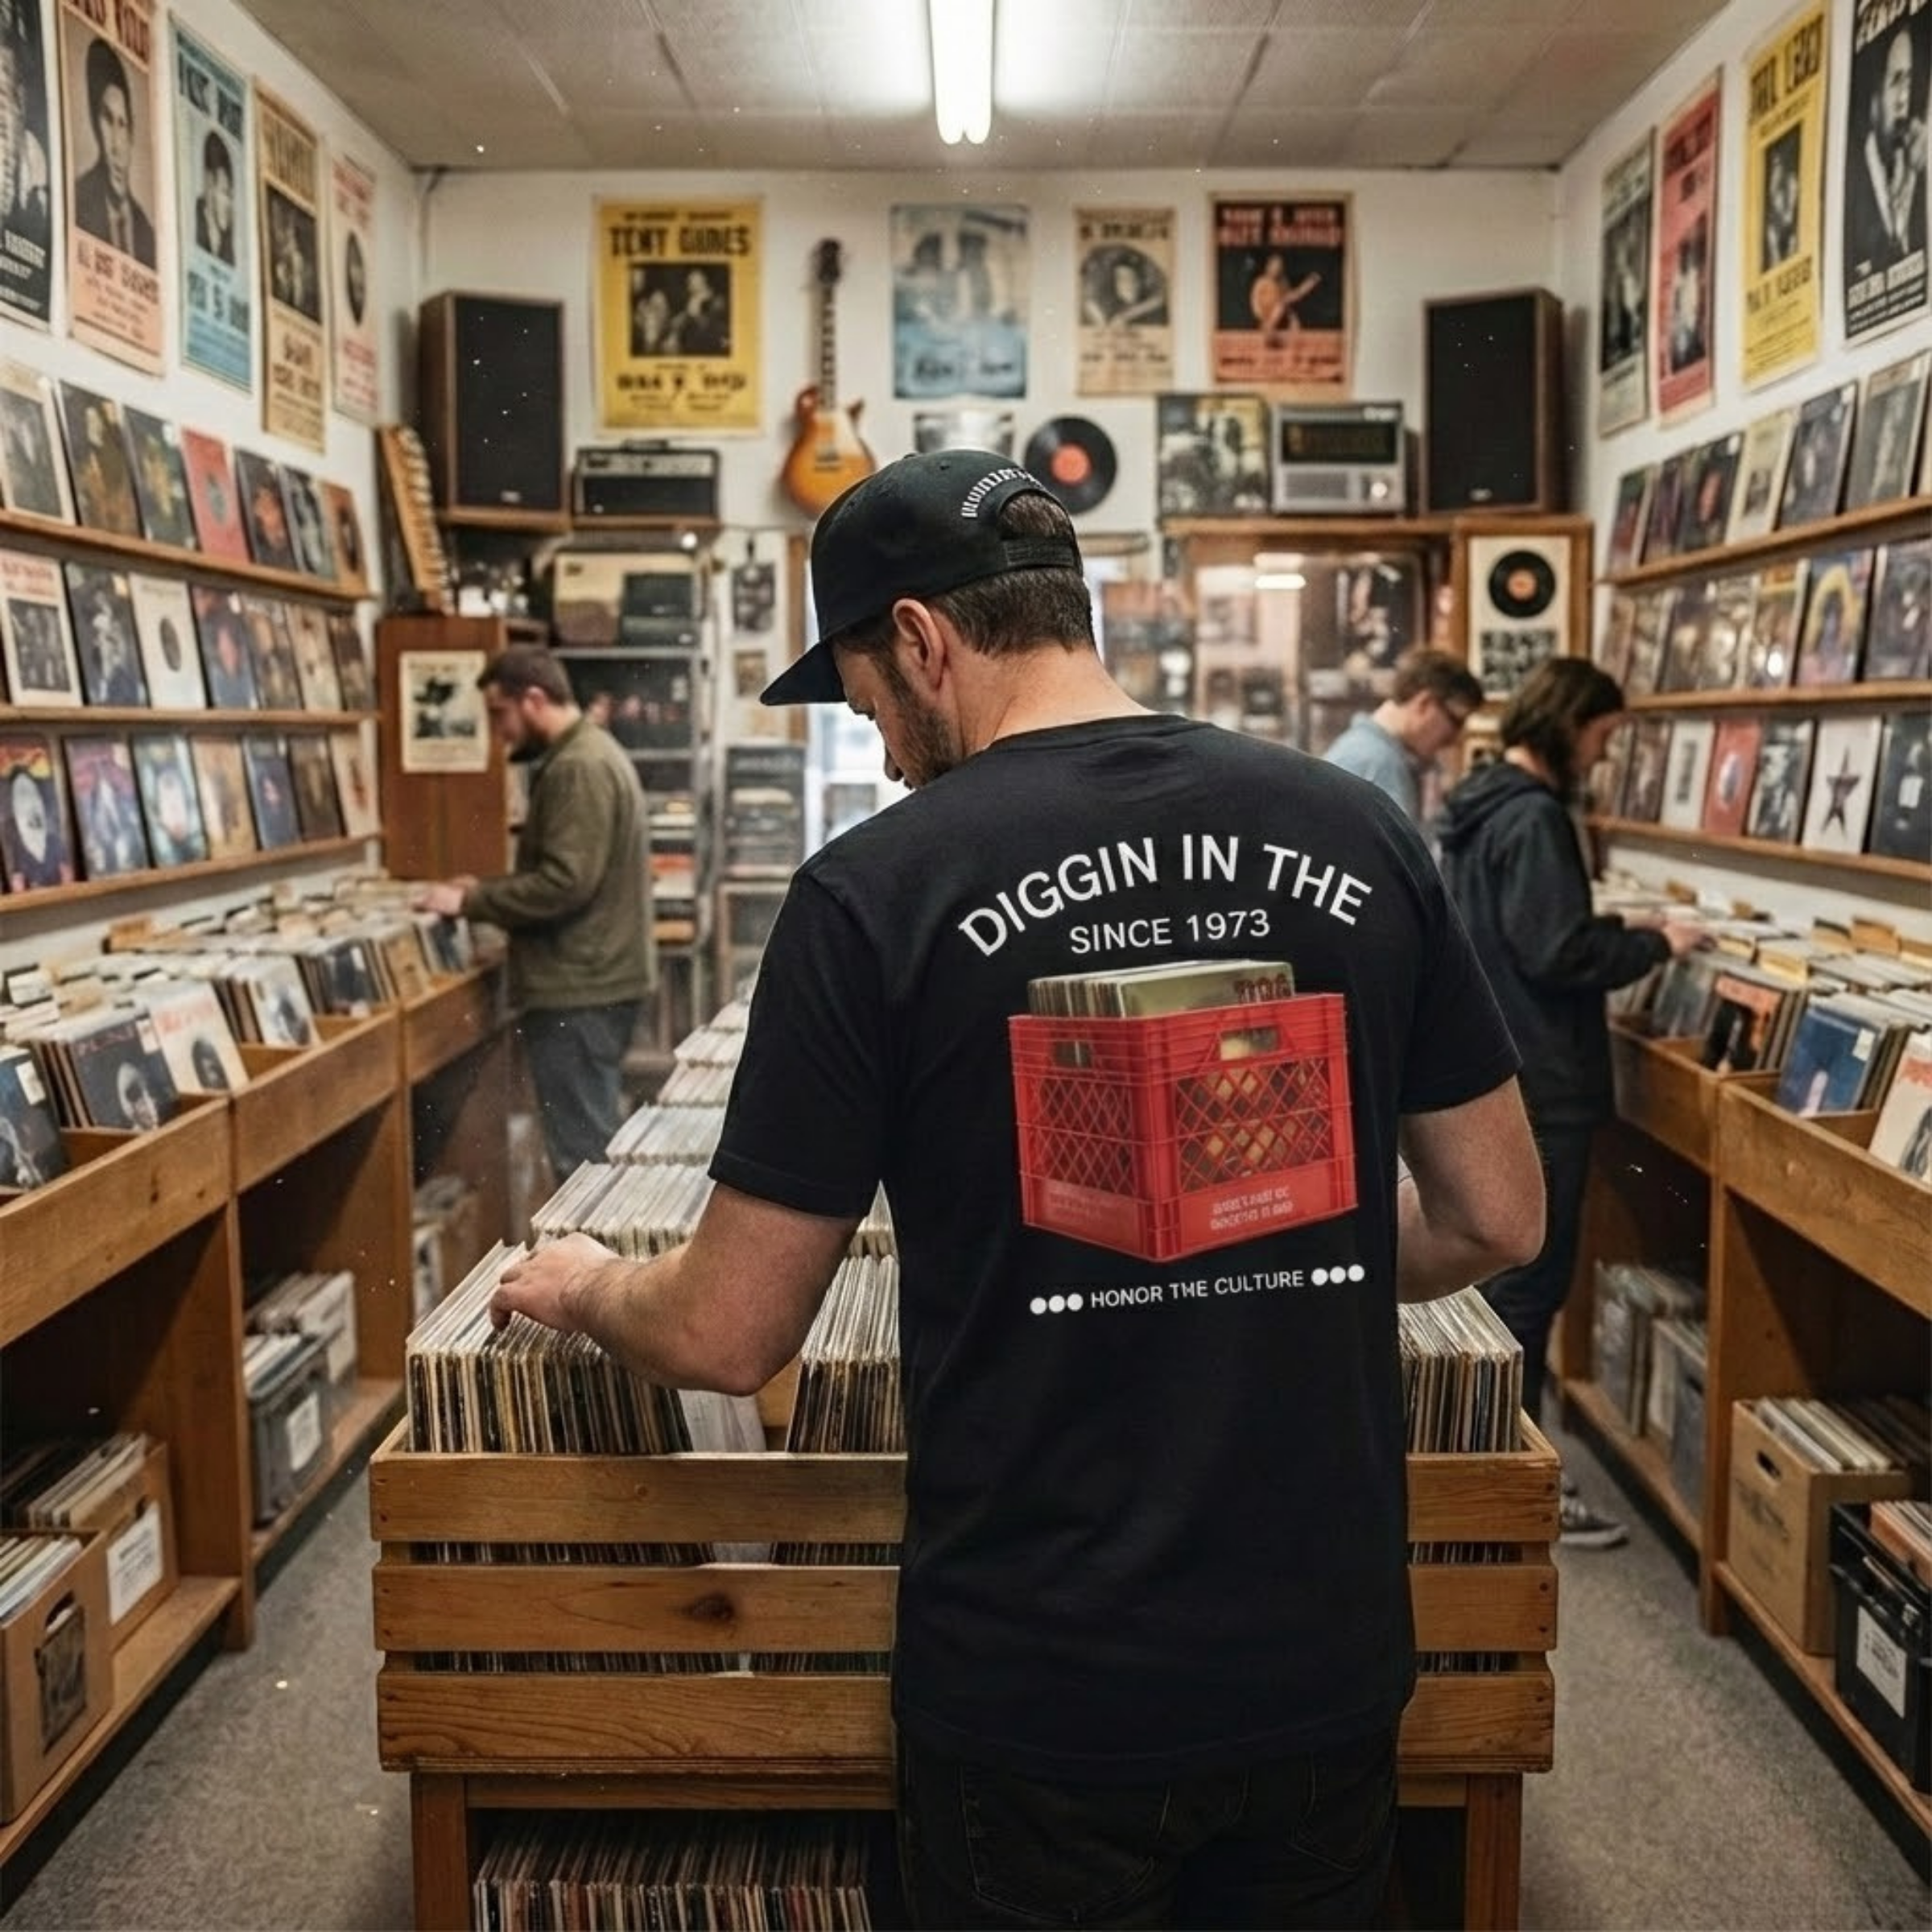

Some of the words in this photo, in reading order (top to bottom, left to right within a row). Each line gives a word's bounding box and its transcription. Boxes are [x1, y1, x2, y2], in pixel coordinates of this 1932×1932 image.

[958, 837, 1158, 956] DIGGIN
[1183, 834, 1239, 882] IN
[1263, 843, 1373, 926] THE
[1069, 918, 1173, 954] SINCE
[1187, 908, 1270, 942] 1973
[1091, 1286, 1163, 1308] HONOR
[1169, 1280, 1208, 1298] THE
[1214, 1269, 1303, 1294] CULTURE
